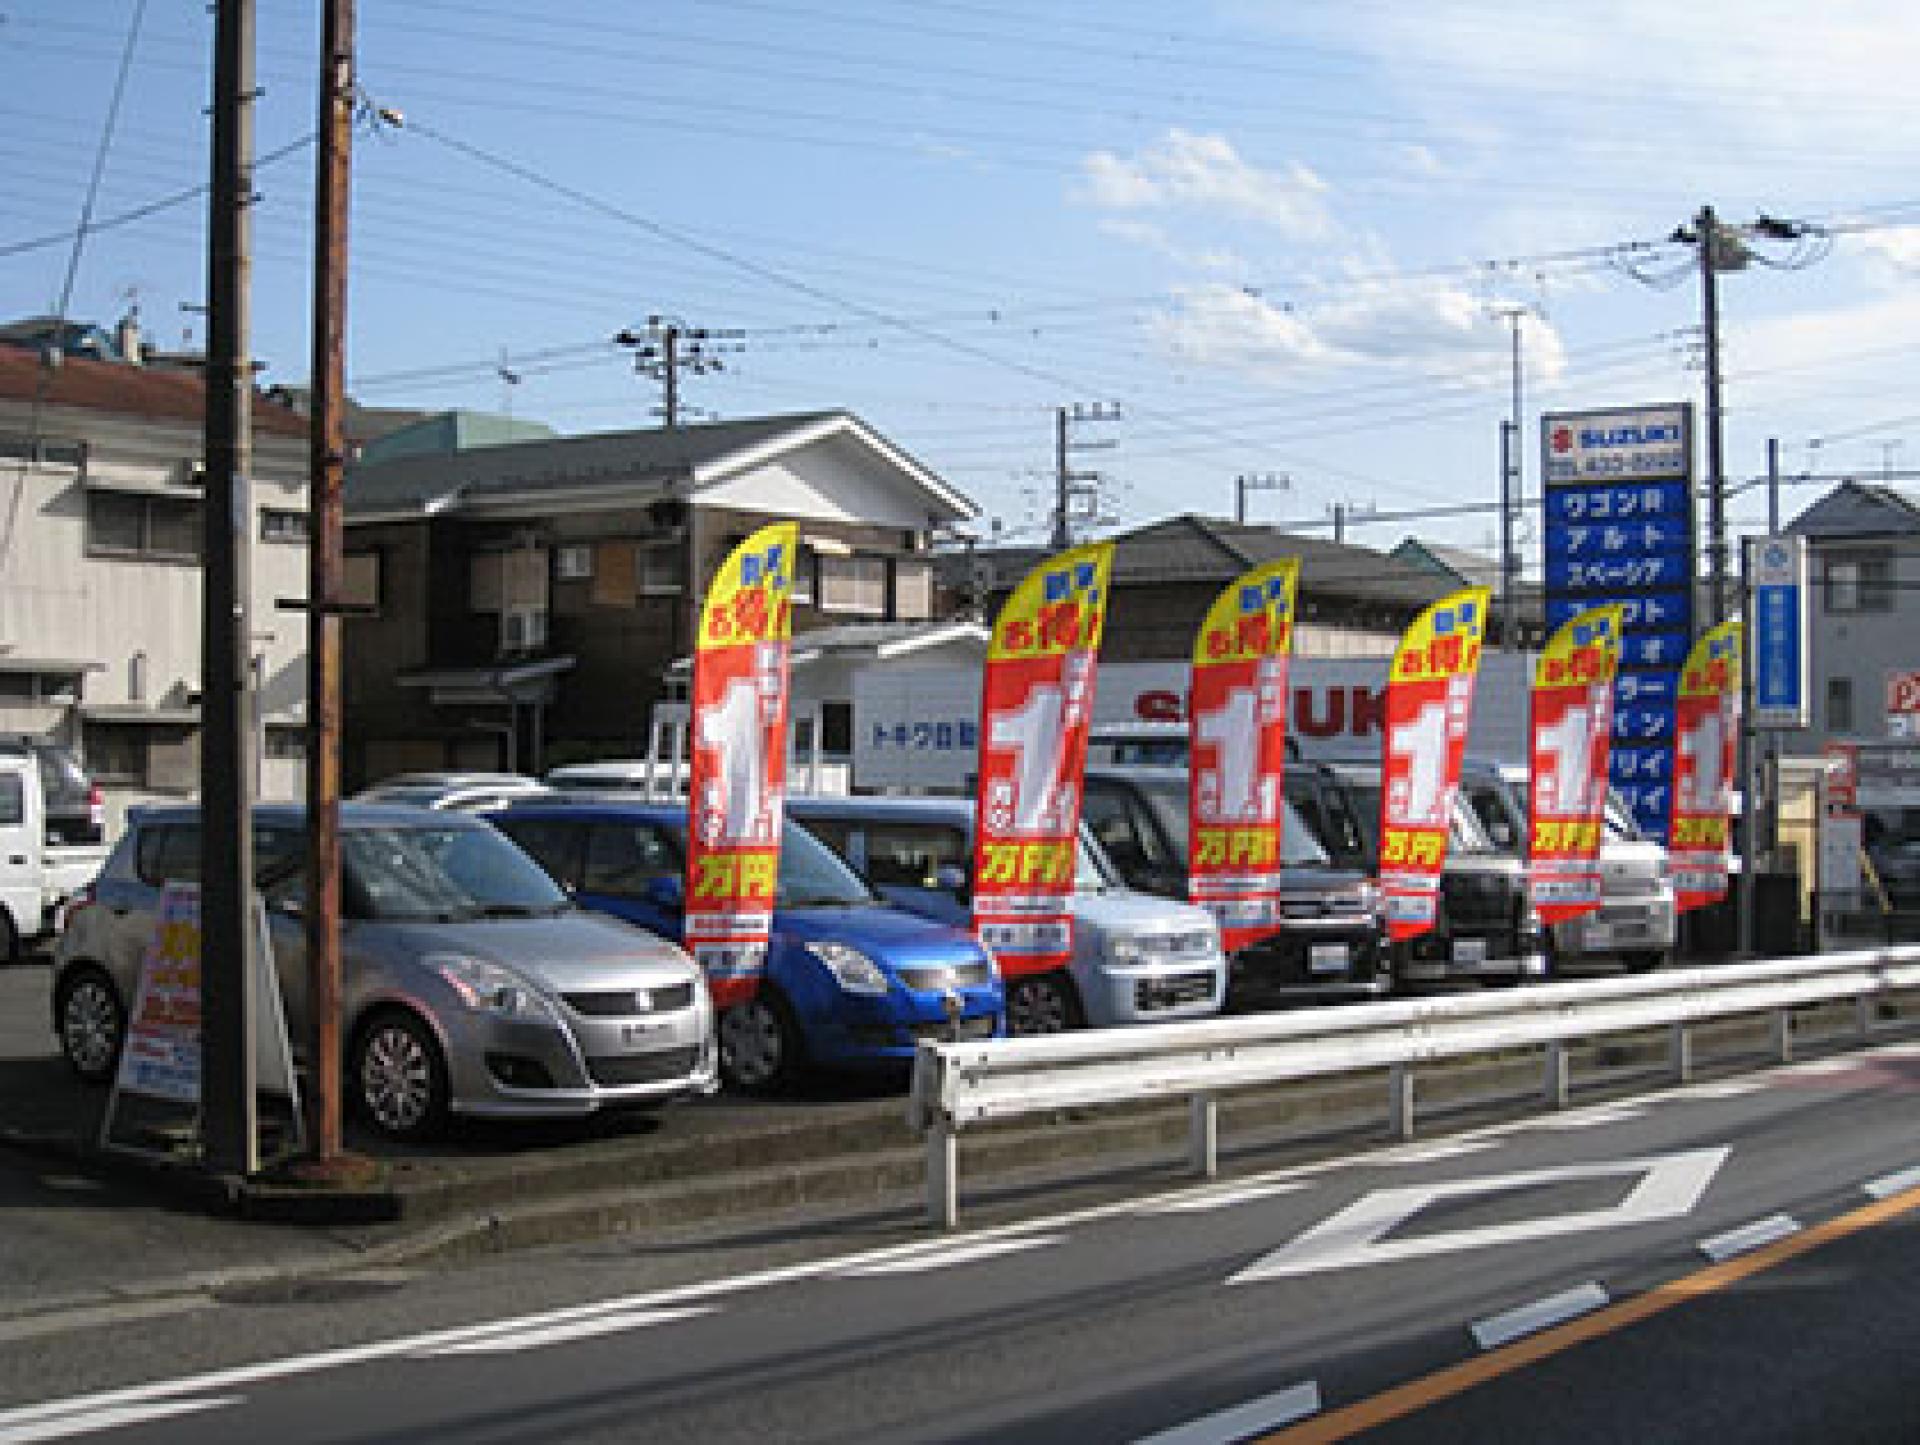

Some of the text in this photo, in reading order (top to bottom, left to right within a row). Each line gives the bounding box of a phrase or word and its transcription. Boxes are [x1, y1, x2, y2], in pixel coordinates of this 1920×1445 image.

[1580, 424, 1679, 449] SUZUKI
[1563, 491, 1665, 518] ワゴンR
[1566, 525, 1665, 551] アルト
[1566, 560, 1665, 588] スペーシア
[1567, 598, 1665, 622] スフト
[1617, 675, 1665, 701] ラー
[1136, 686, 1388, 737] SUK
[693, 853, 777, 899] 万円
